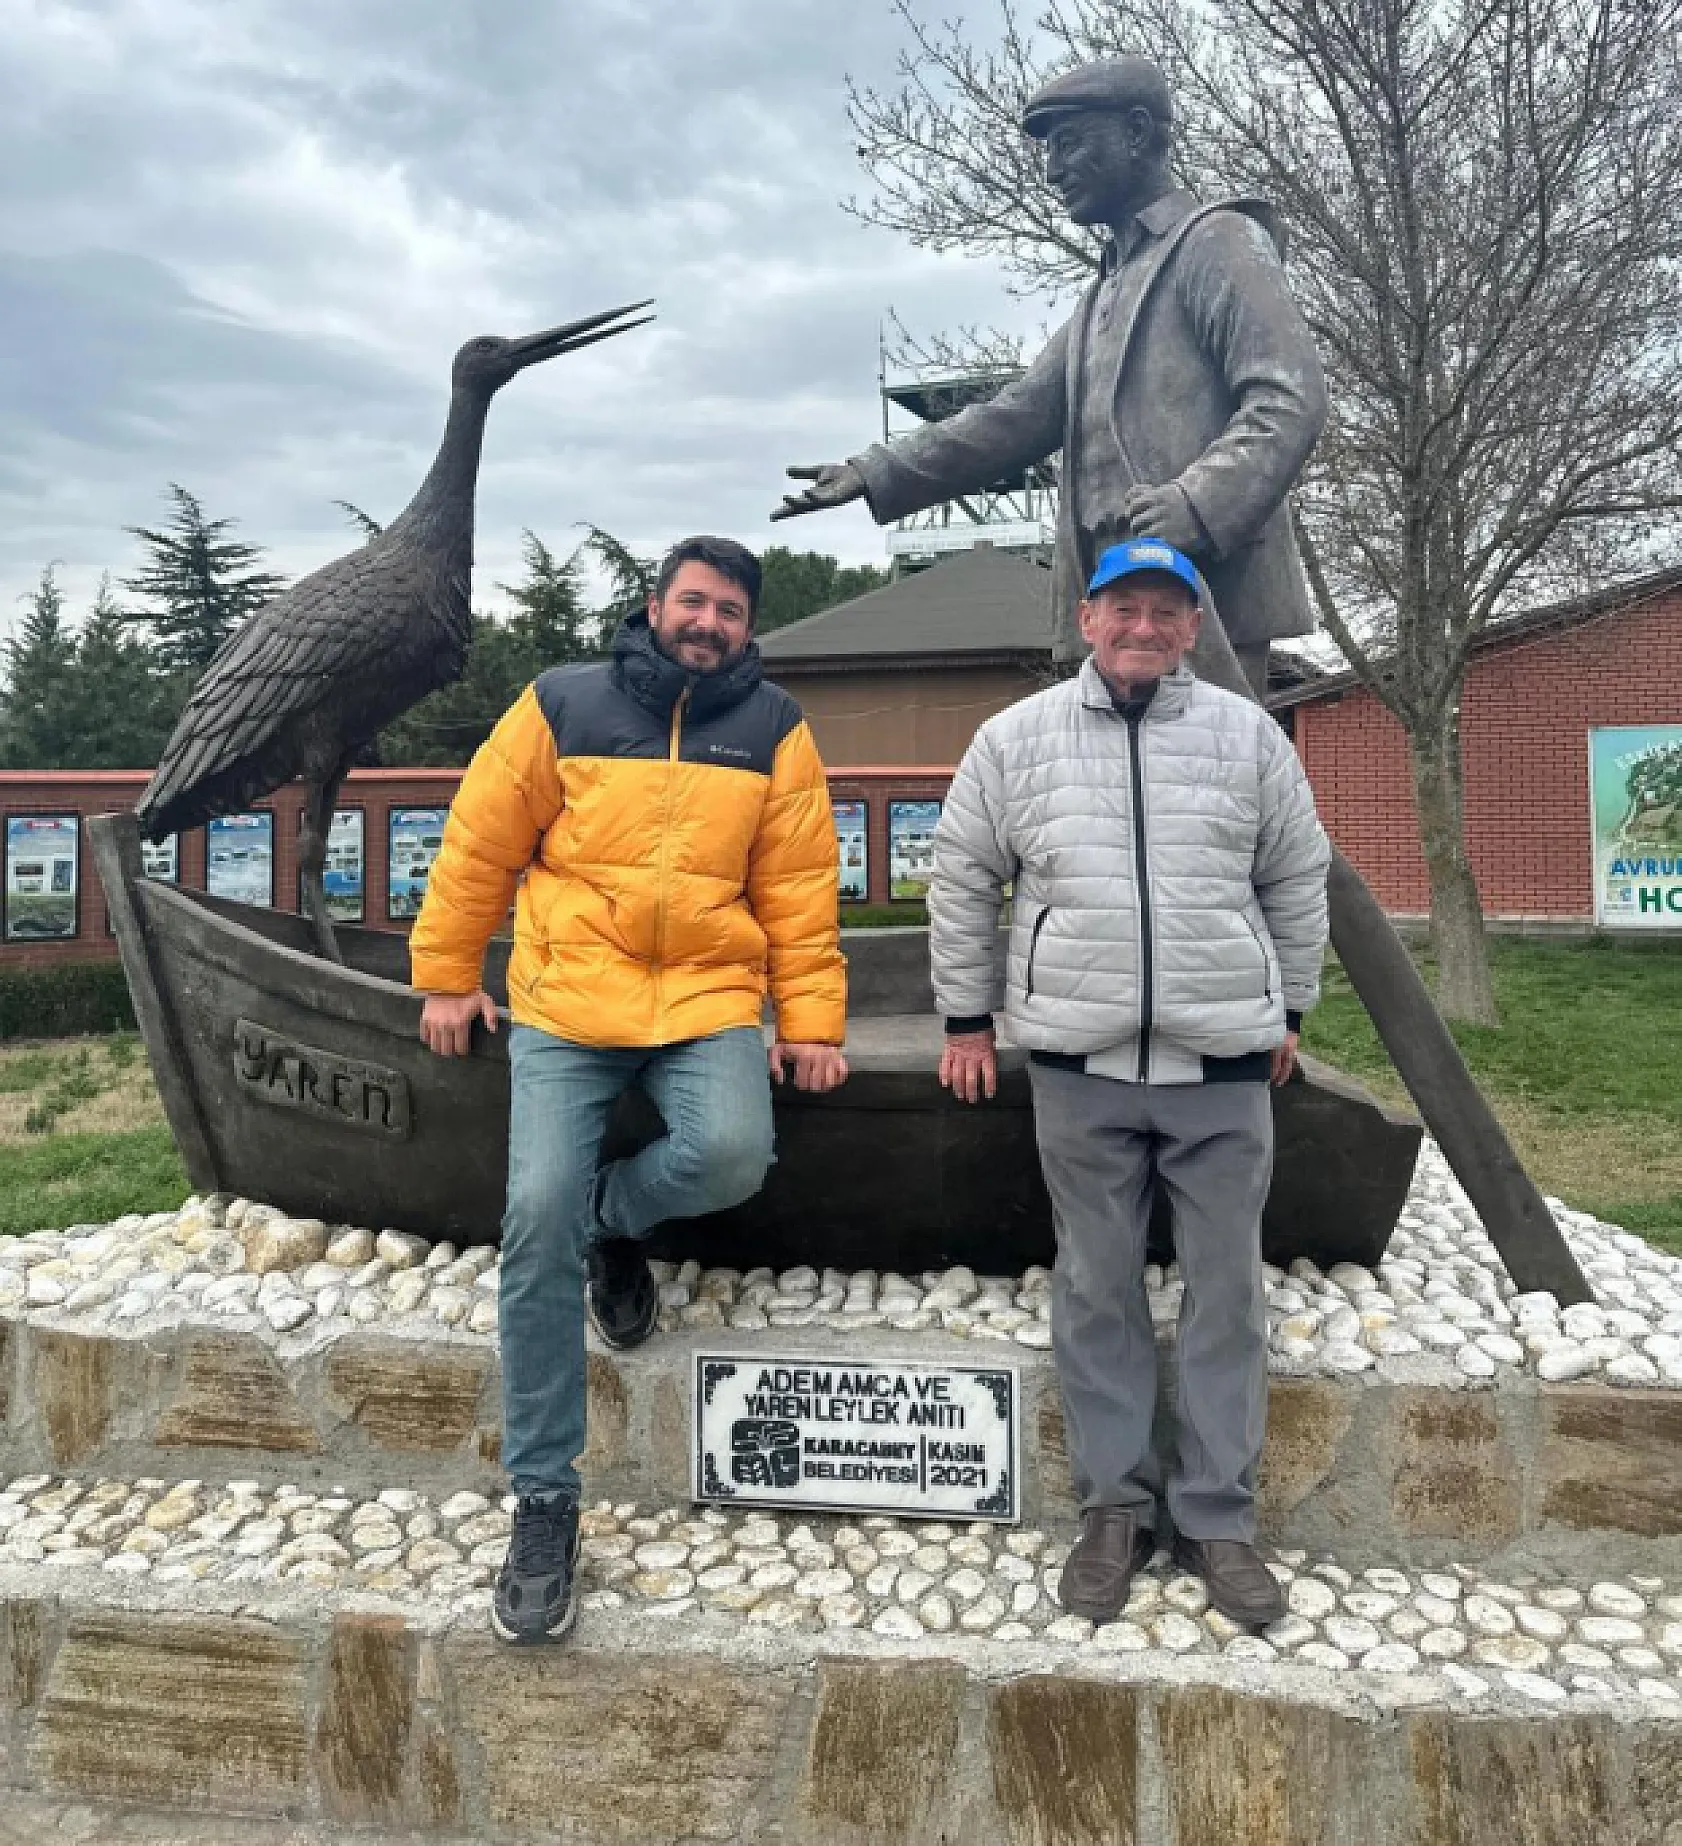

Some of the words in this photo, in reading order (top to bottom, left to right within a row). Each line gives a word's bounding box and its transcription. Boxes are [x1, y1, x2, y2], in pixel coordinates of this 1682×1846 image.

[241, 1035, 393, 1131] YAREN
[756, 1369, 832, 1394] ADEM
[836, 1372, 909, 1399] AMCA
[914, 1376, 950, 1401] VE
[745, 1394, 811, 1419] YAREN
[815, 1397, 899, 1424] LEYLEK
[907, 1401, 967, 1430] ANITI
[929, 1465, 988, 1488] 2021
